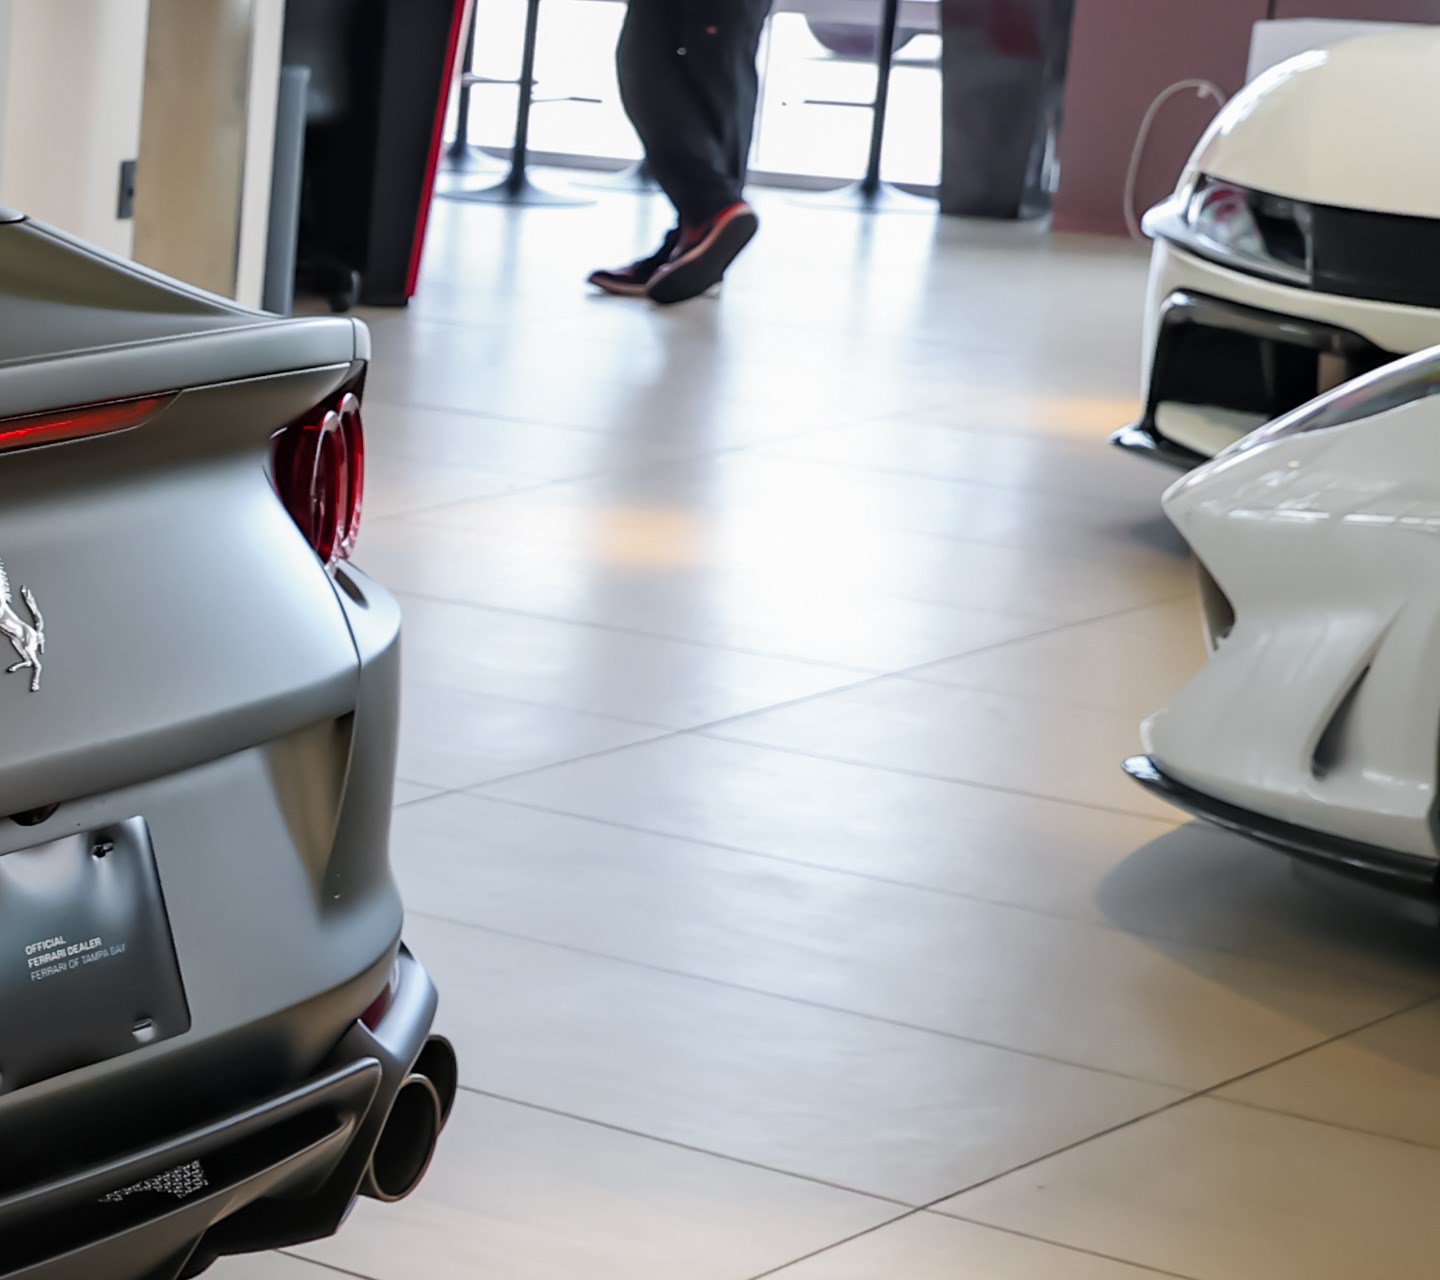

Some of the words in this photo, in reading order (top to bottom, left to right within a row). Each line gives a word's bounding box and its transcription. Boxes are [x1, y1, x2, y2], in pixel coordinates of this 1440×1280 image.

[25, 936, 66, 955] OFFICIAL
[28, 949, 66, 968] FERRARI
[67, 937, 102, 955] DEALER
[31, 963, 67, 981] FERRARI
[69, 958, 79, 969] OF
[82, 949, 109, 963] TAMPA
[110, 943, 126, 955] BAY
